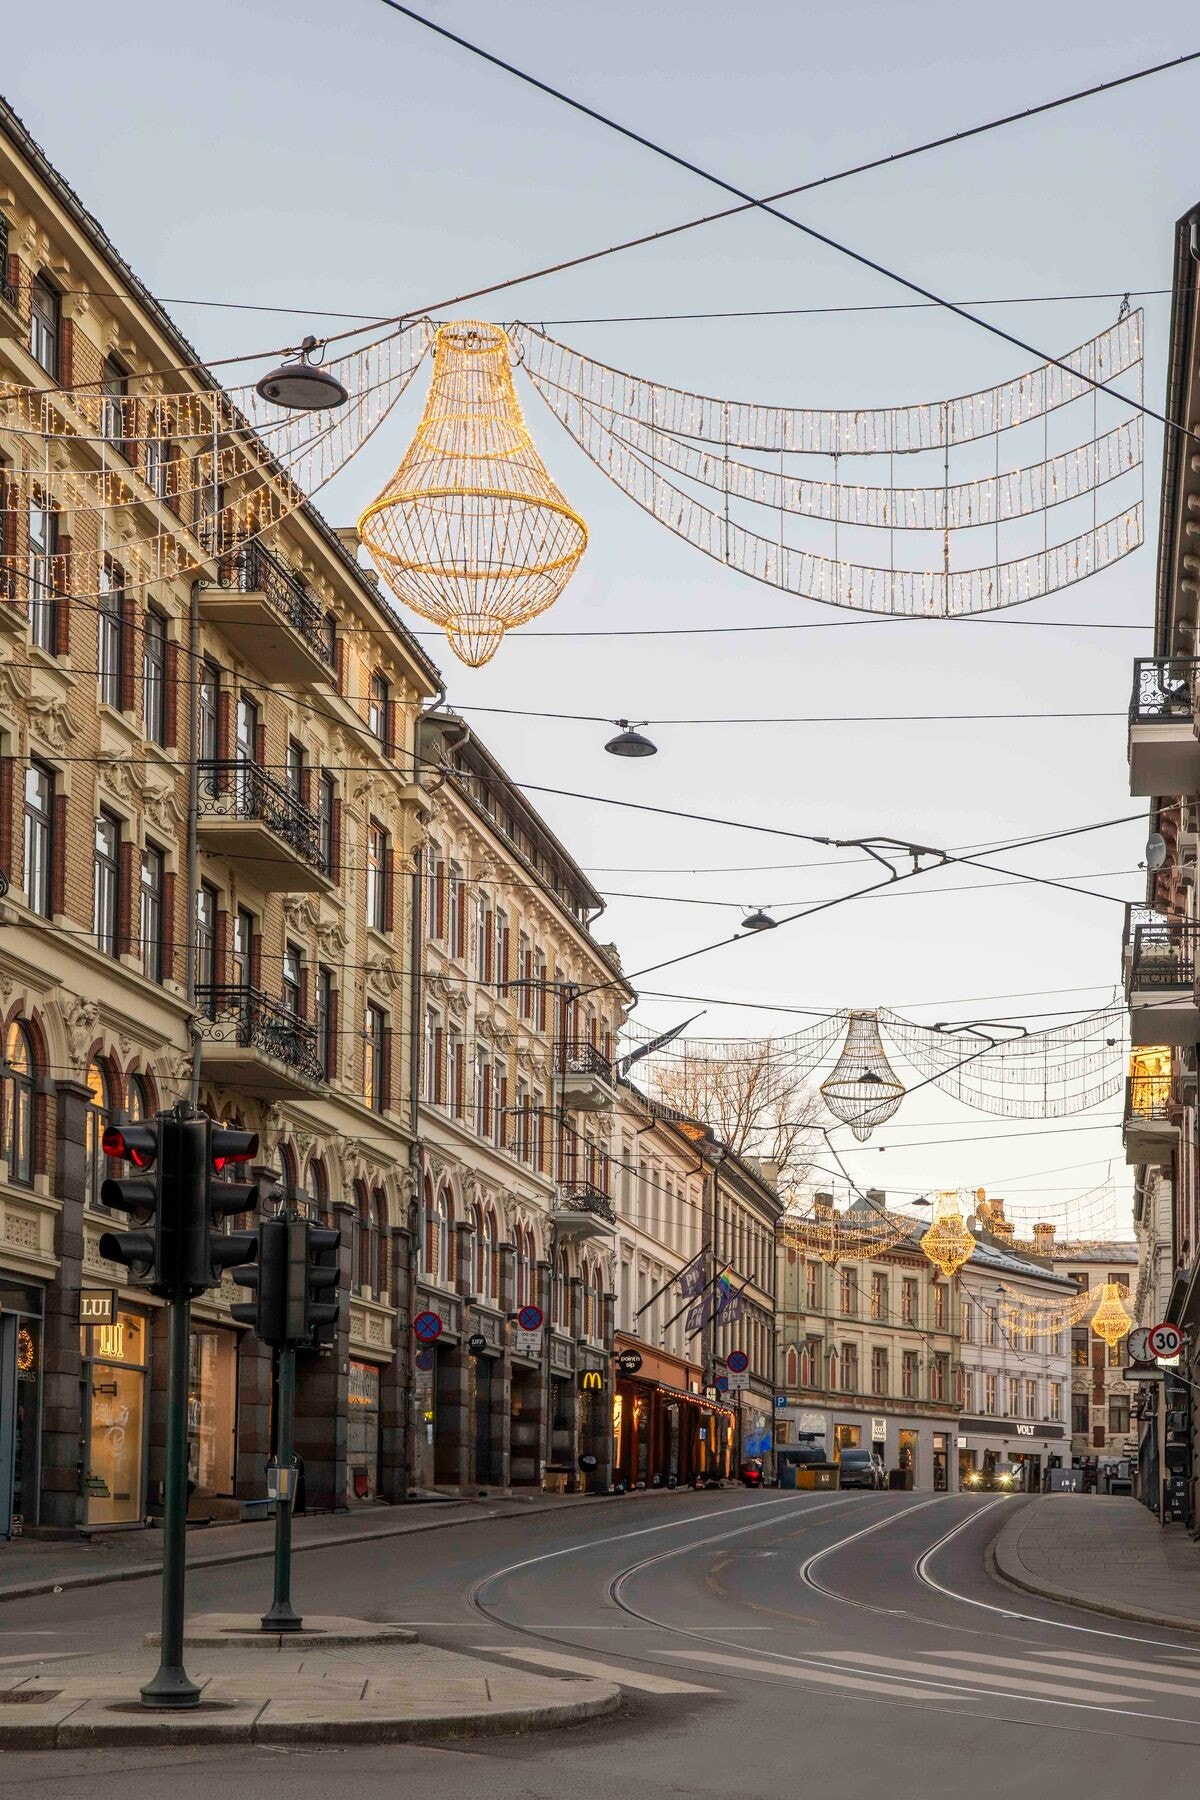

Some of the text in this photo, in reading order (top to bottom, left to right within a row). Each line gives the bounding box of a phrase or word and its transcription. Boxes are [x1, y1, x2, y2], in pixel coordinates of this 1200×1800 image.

[81, 1299, 111, 1316] LUI
[1155, 1332, 1178, 1350] 30
[777, 1396, 785, 1407] P
[1016, 1424, 1036, 1436] VOLT
